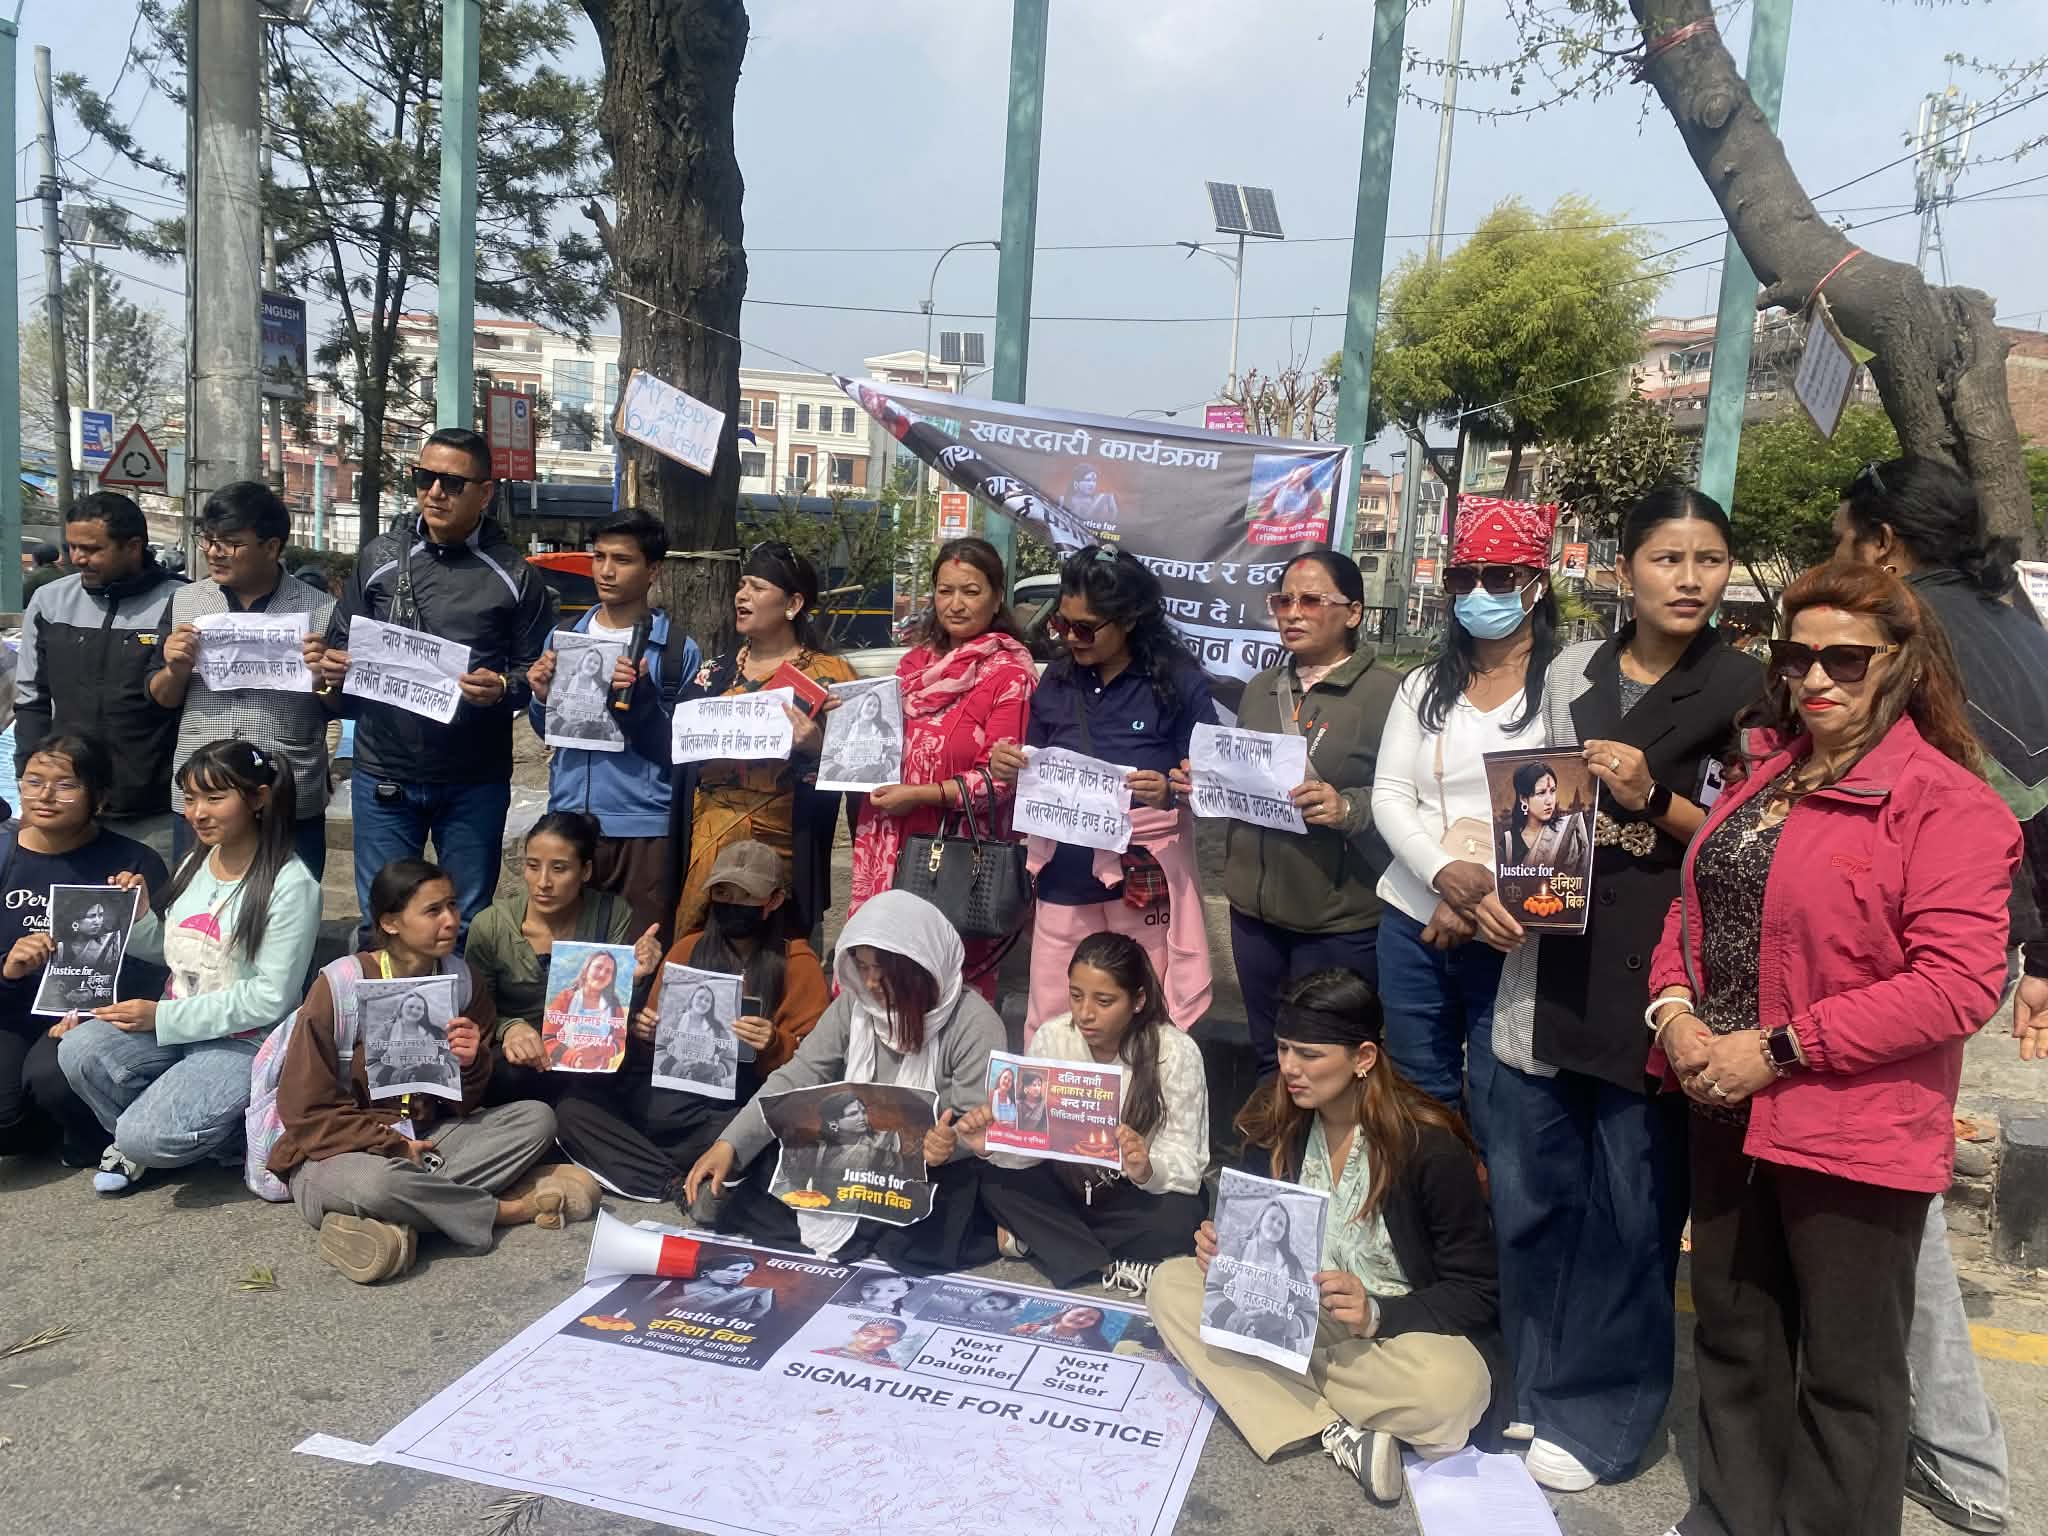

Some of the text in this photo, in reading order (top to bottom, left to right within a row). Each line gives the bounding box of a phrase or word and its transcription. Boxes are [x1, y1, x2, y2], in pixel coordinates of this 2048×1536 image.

[674, 394, 713, 433] BODY
[969, 420, 1093, 456] खबरदारी
[1099, 439, 1223, 471] कार्यक्रम
[1221, 563, 1241, 584] र
[1210, 599, 1231, 624] दे
[1238, 603, 1245, 625] !
[1500, 863, 1554, 878] Justice for
[1549, 872, 1584, 897] इनिशा
[6, 889, 50, 918] Per
[1565, 892, 1585, 909] बिक
[48, 965, 94, 976] Justice for
[1058, 1072, 1080, 1085] दलित
[1061, 1097, 1080, 1109] बन्द
[843, 1168, 886, 1188] Justice
[836, 1185, 912, 1210] इनिशा बिक
[665, 1308, 756, 1331] Justice for
[648, 1319, 757, 1344] इनिशा बिक
[955, 1337, 1004, 1353] Next
[948, 1347, 999, 1365] Your
[1059, 1356, 1110, 1373] Next
[917, 1354, 1017, 1382] Daughter
[1054, 1366, 1105, 1385] Your
[1042, 1377, 1109, 1398] Sister
[782, 1361, 1165, 1449] SIGNATURE FOR JUSTICE
